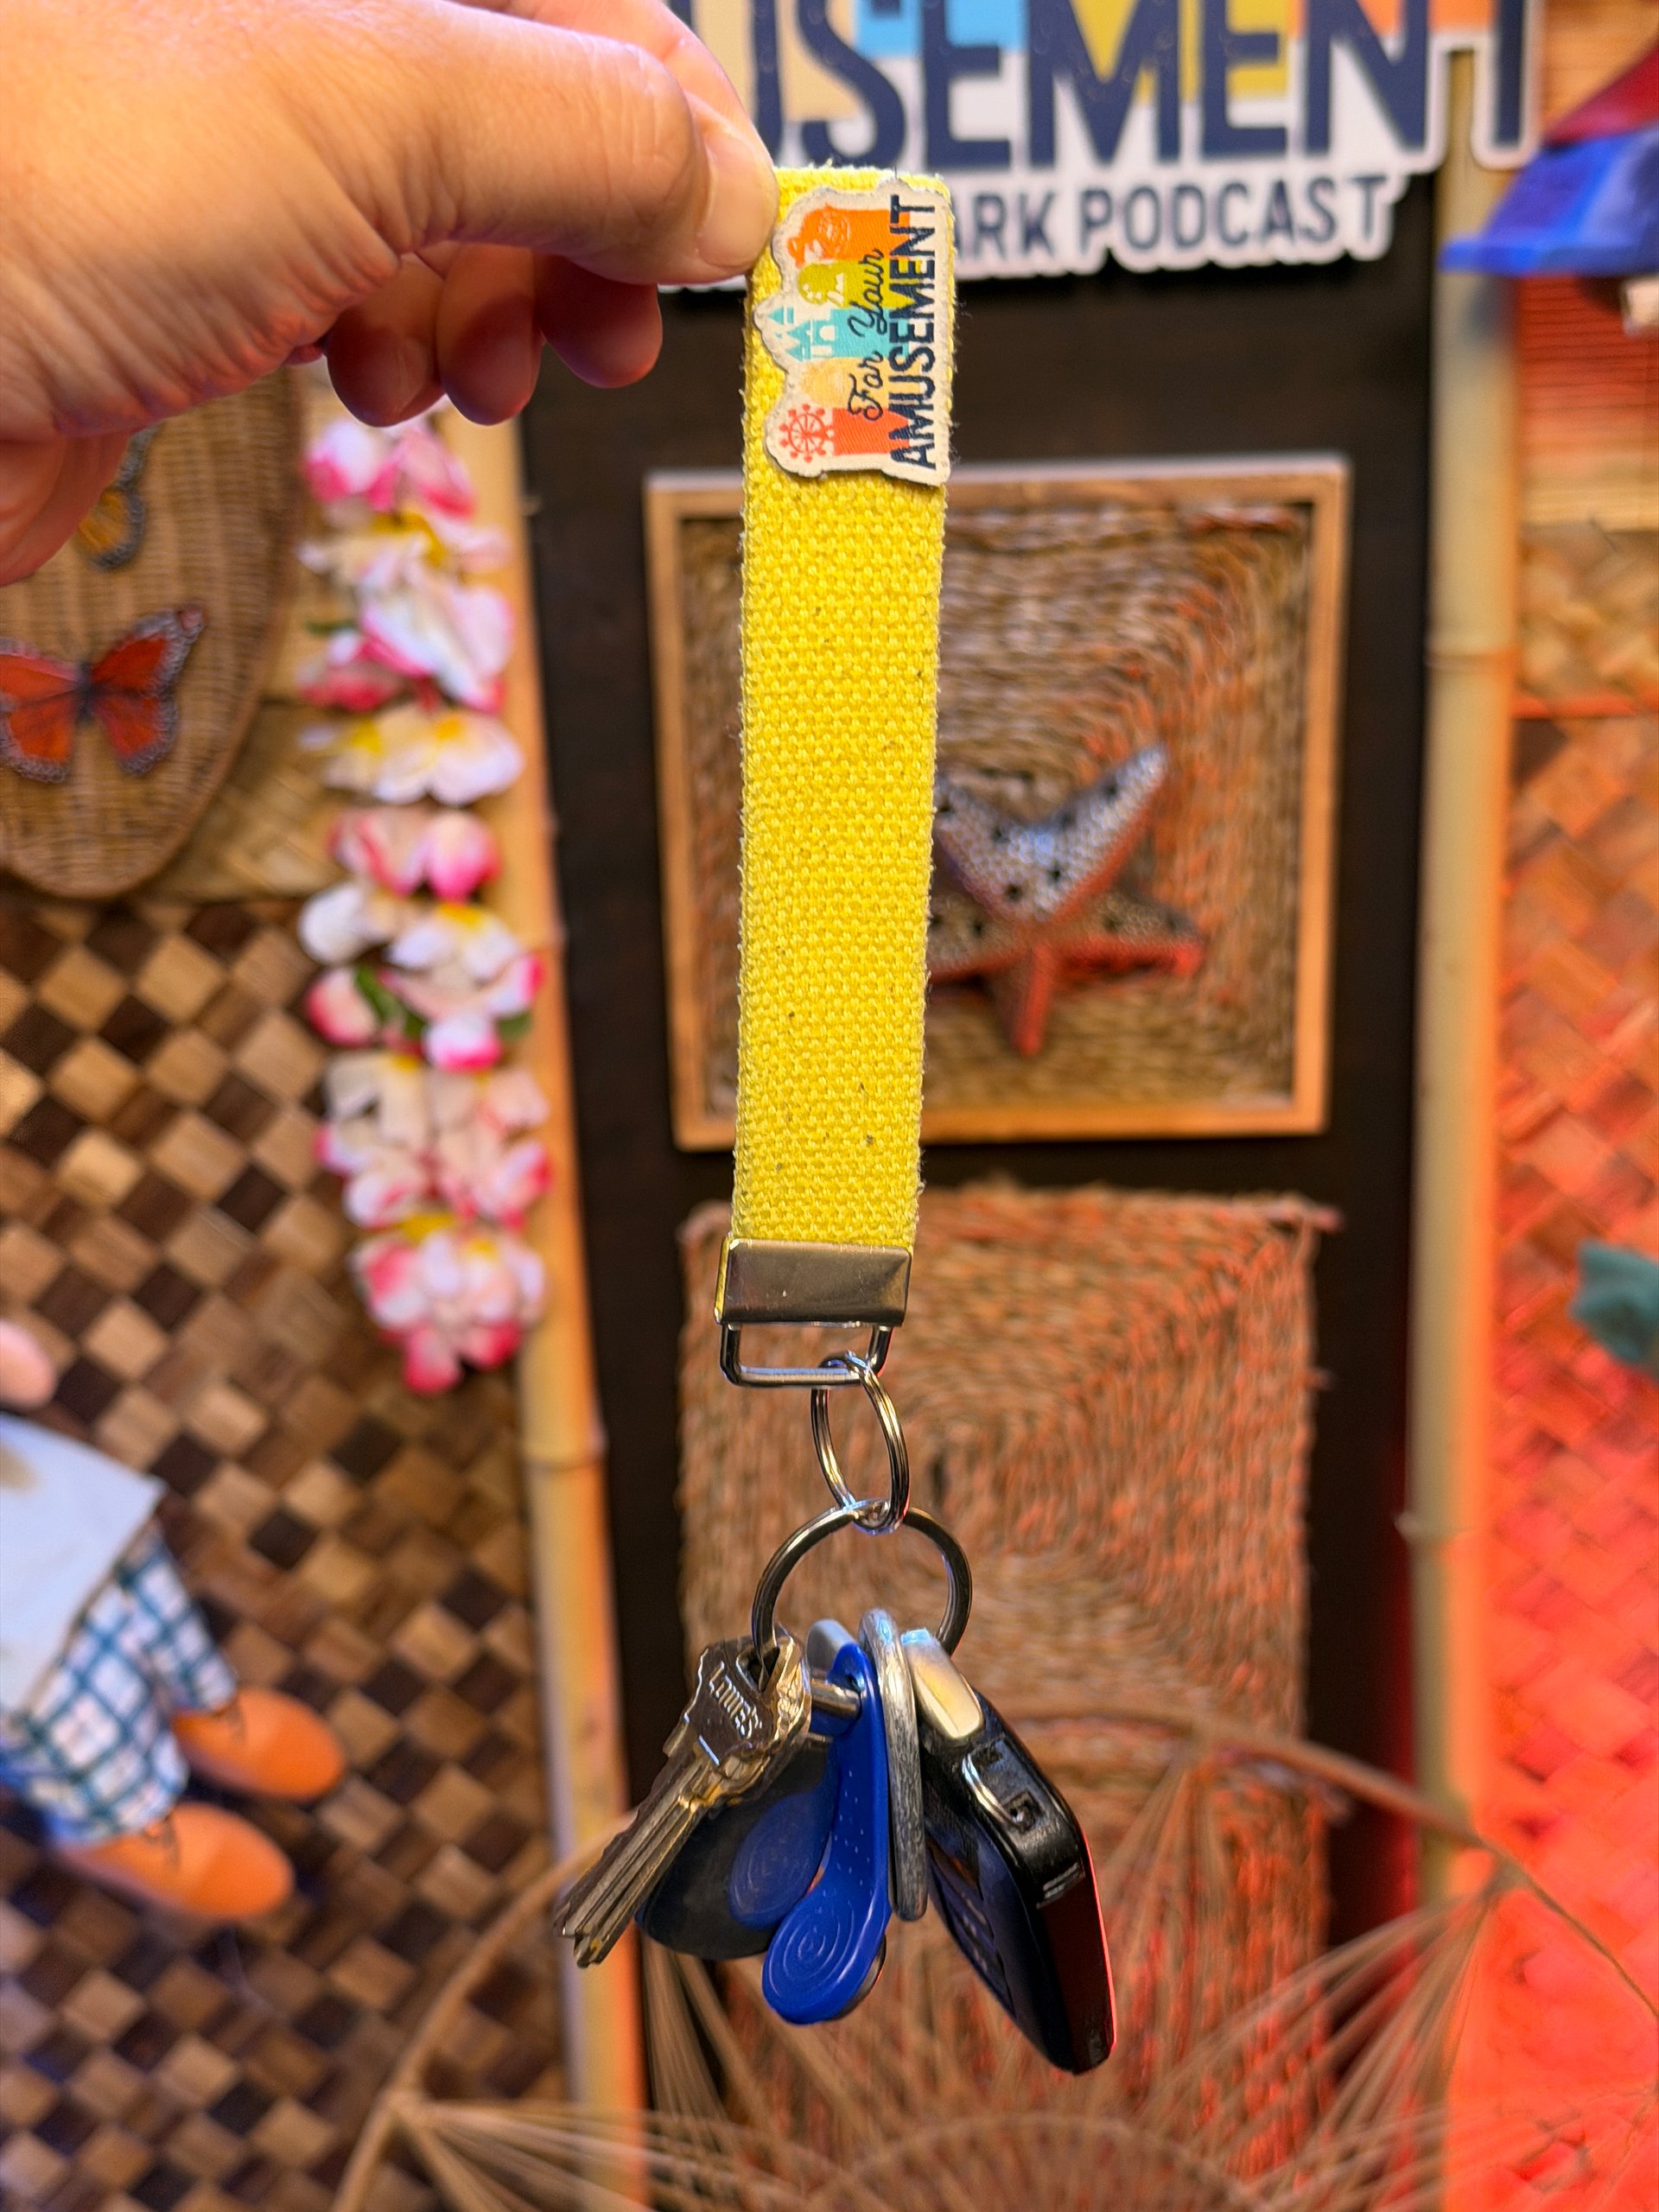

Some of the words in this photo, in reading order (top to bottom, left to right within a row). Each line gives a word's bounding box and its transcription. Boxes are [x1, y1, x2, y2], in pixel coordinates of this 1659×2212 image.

[1079, 172, 1388, 252] PODCAST
[847, 249, 887, 337] Your
[889, 194, 936, 469] AMUSEMENT
